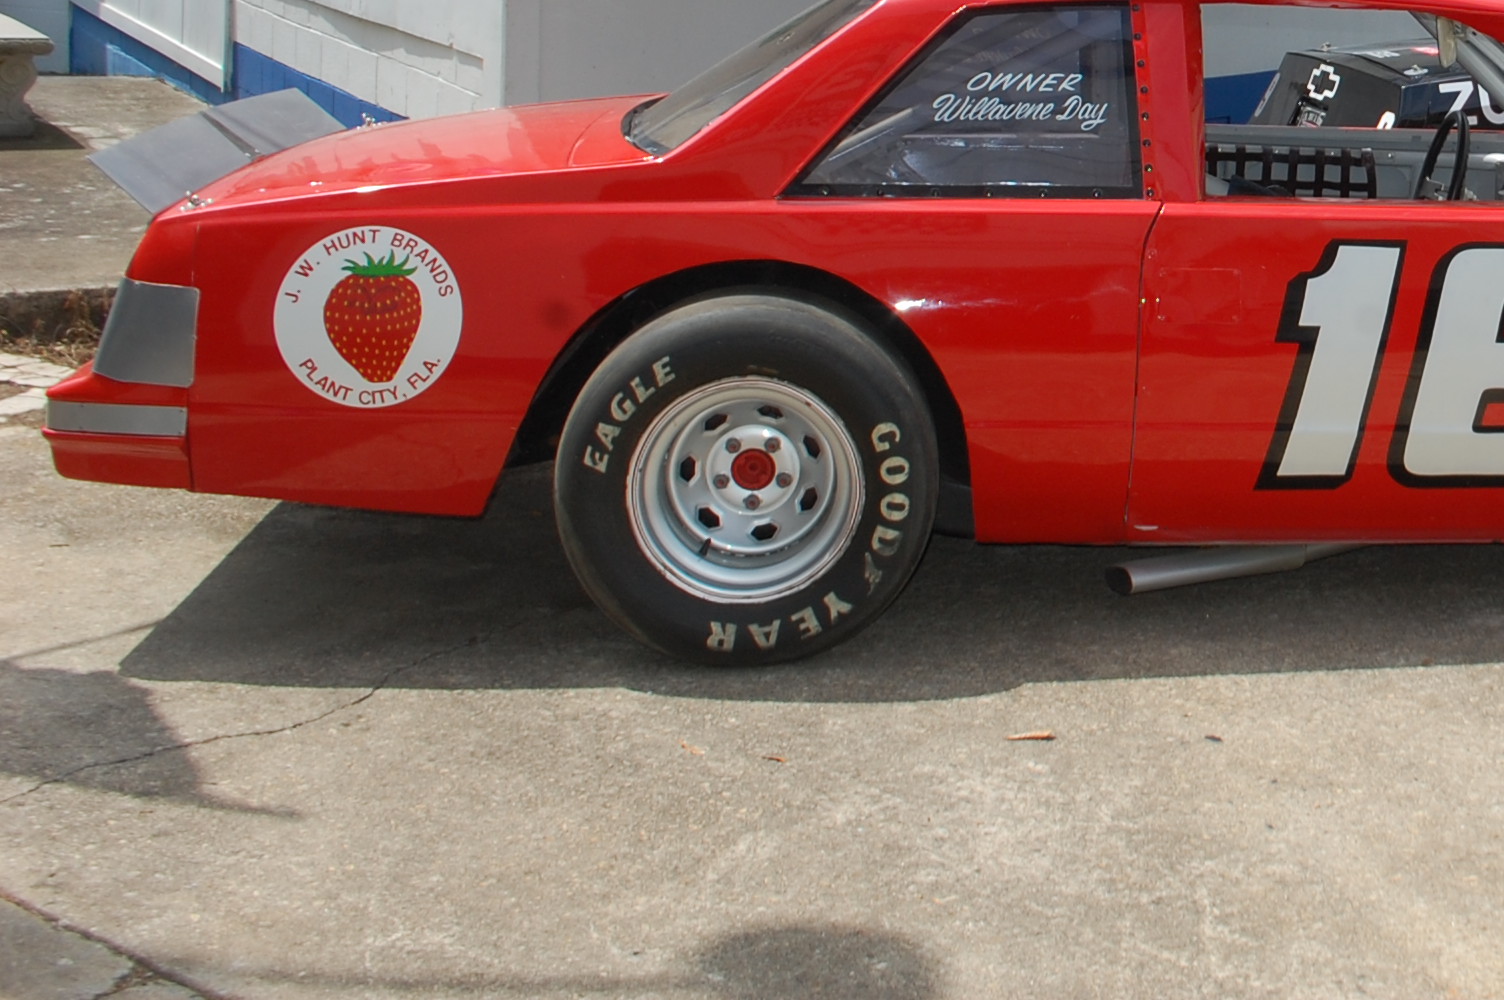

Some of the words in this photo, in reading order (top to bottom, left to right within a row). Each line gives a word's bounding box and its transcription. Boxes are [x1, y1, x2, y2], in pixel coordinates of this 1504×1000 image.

[967, 72, 1082, 92] OWNER
[933, 94, 1054, 122] Willavene
[1055, 95, 1108, 131] Day
[294, 258, 321, 279] W.
[323, 229, 381, 256] HUNT
[390, 232, 454, 297] BRANDS
[299, 358, 354, 401] PLANT
[406, 356, 441, 390] FLA.
[583, 355, 676, 474] EAGLE
